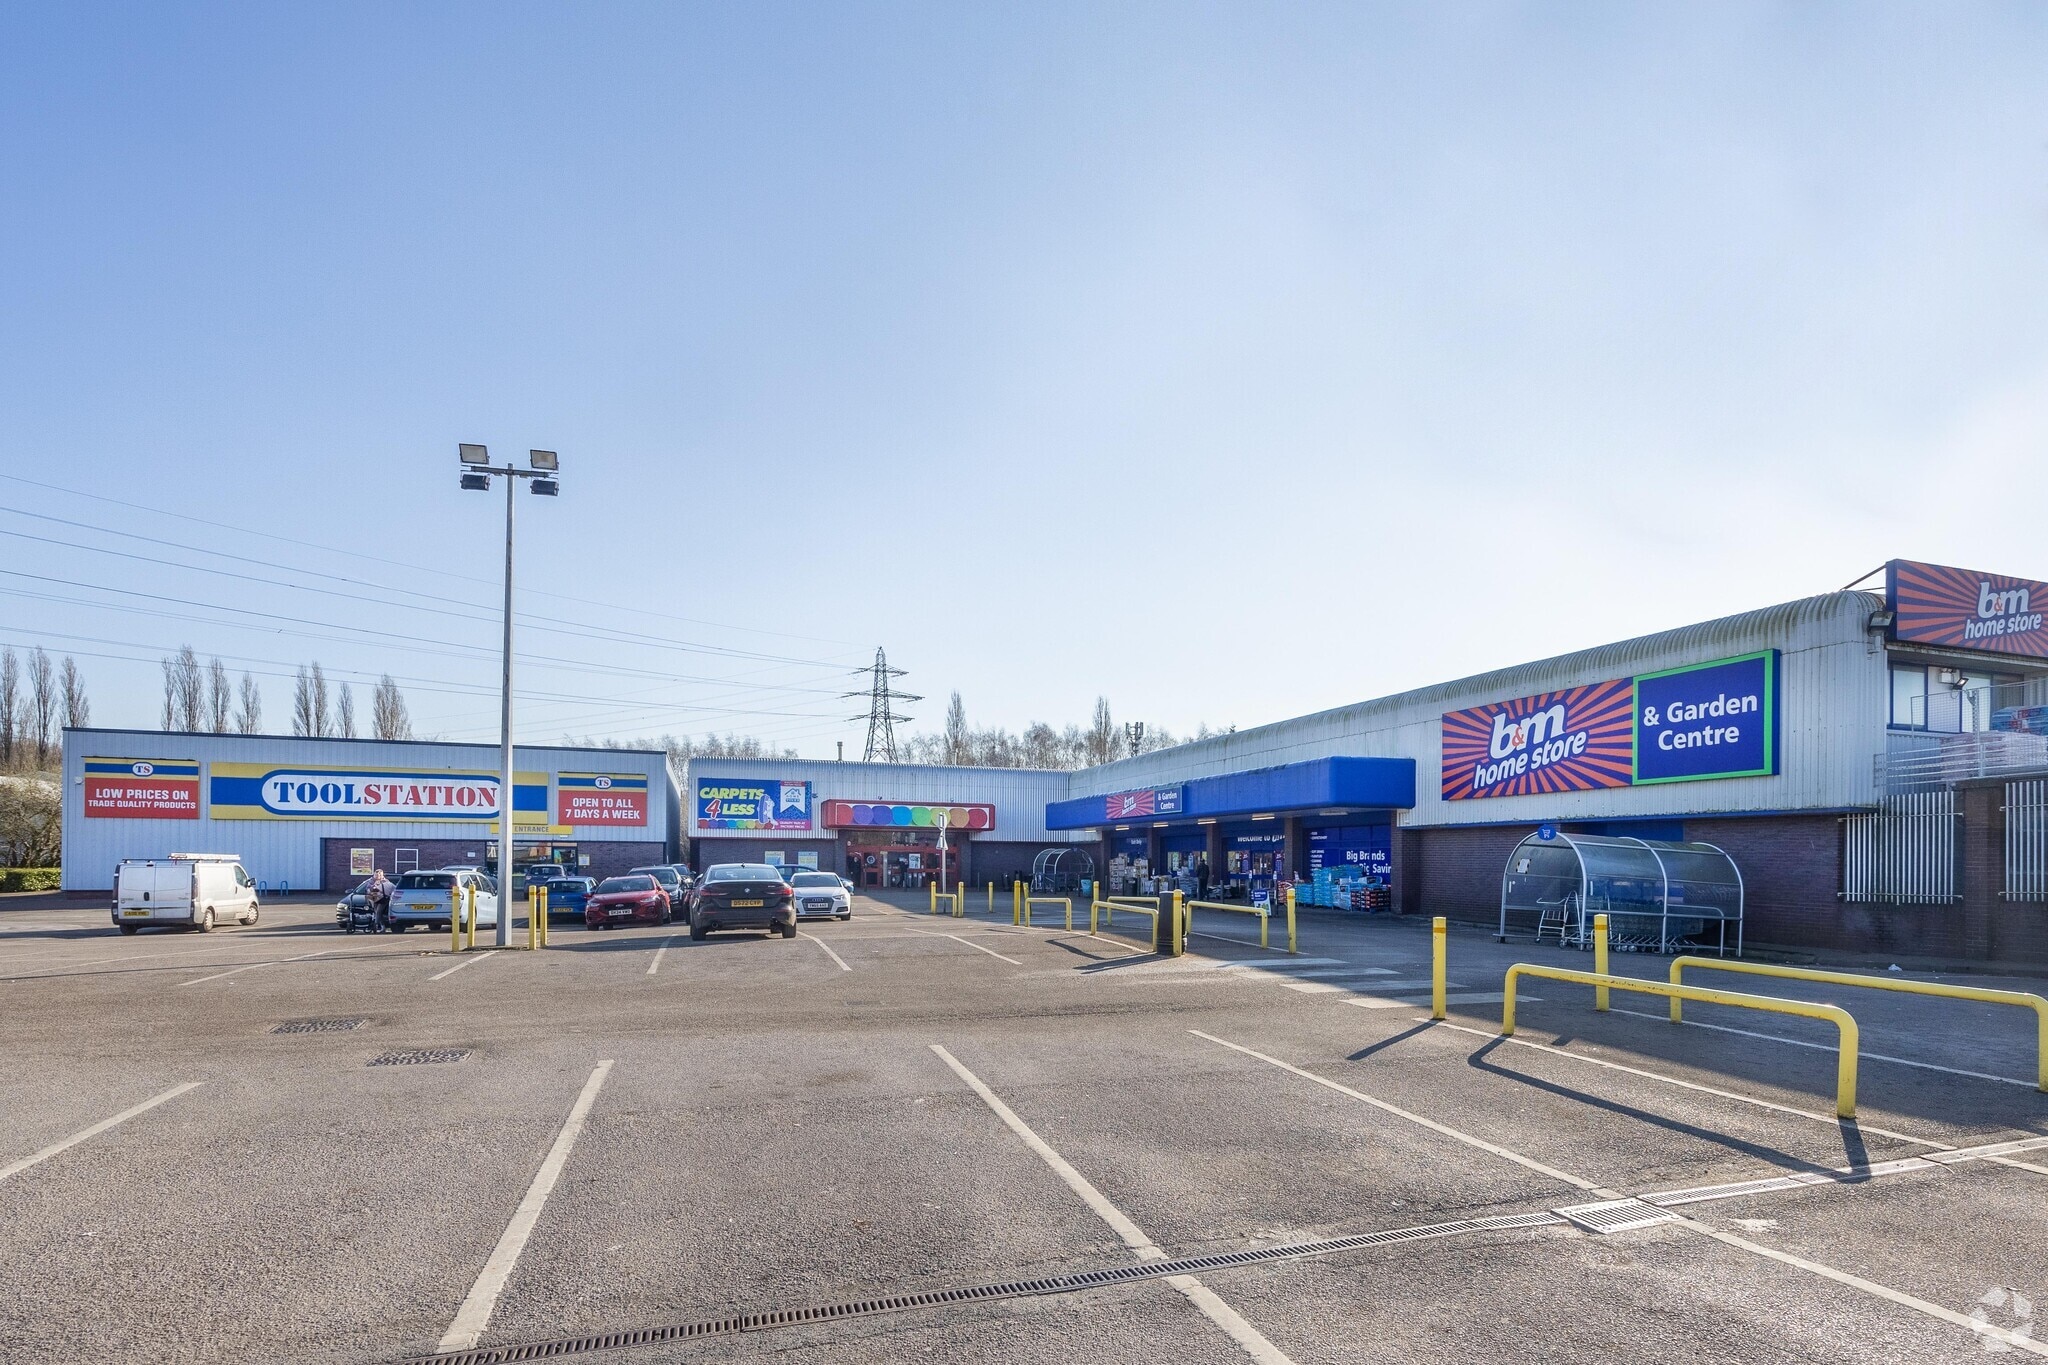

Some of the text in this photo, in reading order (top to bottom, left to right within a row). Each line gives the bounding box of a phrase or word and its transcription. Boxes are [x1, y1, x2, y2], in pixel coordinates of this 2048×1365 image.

[1978, 582, 2029, 618] b&m
[1965, 614, 2042, 639] home store
[1643, 693, 1757, 727] & Garden
[1490, 704, 1566, 759] b&m
[1658, 725, 1740, 751] Centre
[1474, 731, 1586, 789] home store
[135, 765, 151, 773] TS
[96, 788, 189, 800] LOW PRICES ON
[273, 782, 497, 807] TOOLSTATION
[699, 787, 765, 800] CARPETS
[1162, 791, 1178, 800] Garden
[572, 797, 633, 808] OPEN TO ALL
[705, 799, 755, 819] 4 LESS
[1160, 802, 1175, 810] Centre
[565, 809, 641, 819] 7 DAYS A WEEK
[1346, 850, 1358, 862] Big
